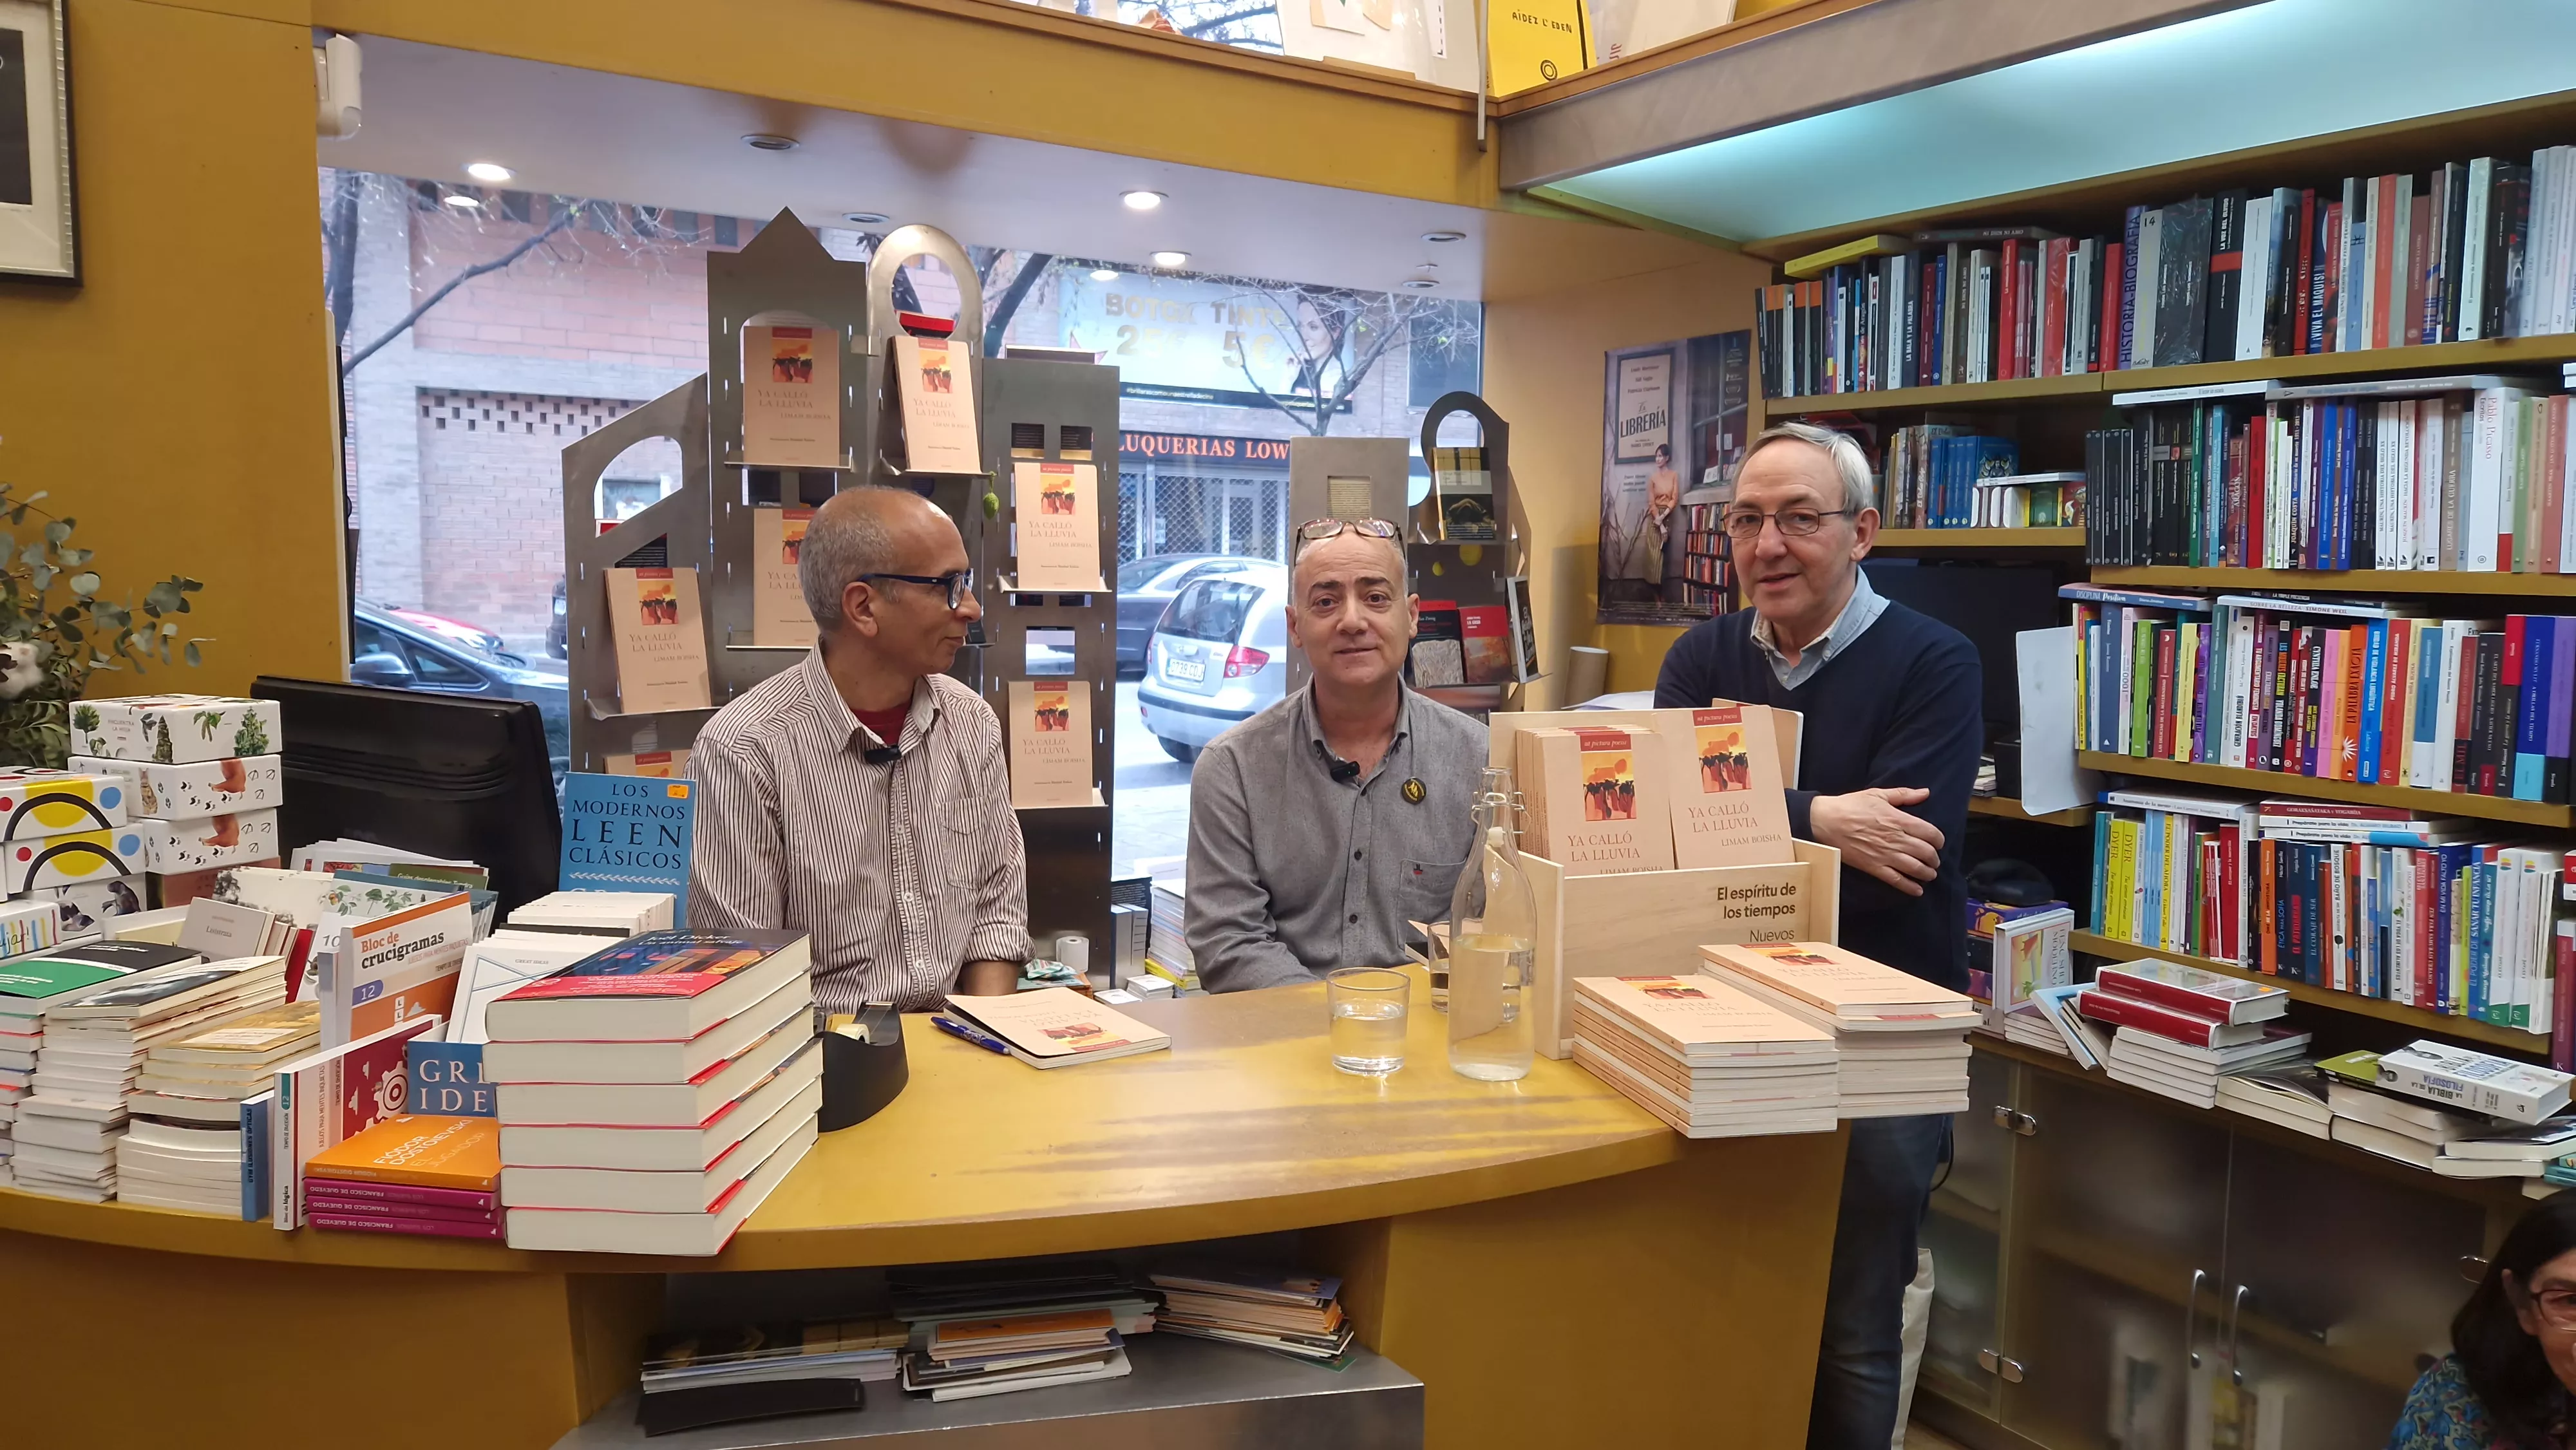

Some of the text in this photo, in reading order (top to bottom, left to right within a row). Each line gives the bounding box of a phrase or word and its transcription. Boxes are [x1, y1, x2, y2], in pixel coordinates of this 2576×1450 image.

[1551, 20, 1572, 33] EDEN
[2313, 273, 2324, 317] EL MAQUIS!
[1106, 293, 1197, 325] BOTOX
[914, 398, 923, 407] YA
[1620, 406, 1666, 438] LIBRERÍA
[2486, 397, 2497, 460] Pablo Picasso
[1245, 440, 1290, 460] LOW
[2076, 590, 2101, 600] DISCIPLINA
[645, 632, 676, 641] CALLÓ
[2310, 646, 2321, 688] CYNTHIA ENLOE
[2277, 673, 2286, 695] FACTURAN
[2347, 682, 2359, 712] PALABRA
[1704, 715, 1722, 723] pictura
[2275, 700, 2284, 720] YOLANDA
[2234, 721, 2242, 747] GENERACIÓN
[2273, 721, 2284, 747] DOMÍNGUEZ
[612, 784, 649, 798] LOS
[573, 800, 685, 820] MODERNOS
[1688, 801, 1749, 818] YA CALLÓ
[571, 818, 683, 849] LEEN
[1692, 816, 1758, 833] LA LLUVIA
[1567, 831, 1632, 847] YA CALLÓ
[1721, 834, 1782, 847] LIMAM BOISHA
[2110, 831, 2119, 859] DYER
[2123, 834, 2133, 863] DYER
[569, 846, 681, 869] CLÁSICOS
[1571, 848, 1640, 862] LA LLUVIA
[1717, 882, 1796, 902] El espíritu de
[1723, 904, 1795, 919] los tiempos
[2472, 910, 2480, 937] SANAR
[361, 932, 399, 954] Bloc de
[1750, 930, 1794, 943] Nuevos
[361, 932, 444, 970] crucigramas
[433, 946, 449, 957] MENTES
[2311, 947, 2316, 956] EL
[361, 985, 375, 1001] 12
[2423, 1075, 2463, 1091] FILOSOFÍA
[2428, 1086, 2454, 1100] BIBLIA
[283, 1096, 289, 1105] 12
[374, 1135, 429, 1164] FIÓDOR
[389, 1120, 474, 1165] DOSTOIEVSKI
[430, 1133, 485, 1167] JUGADOR
[410, 1158, 433, 1167] EL
